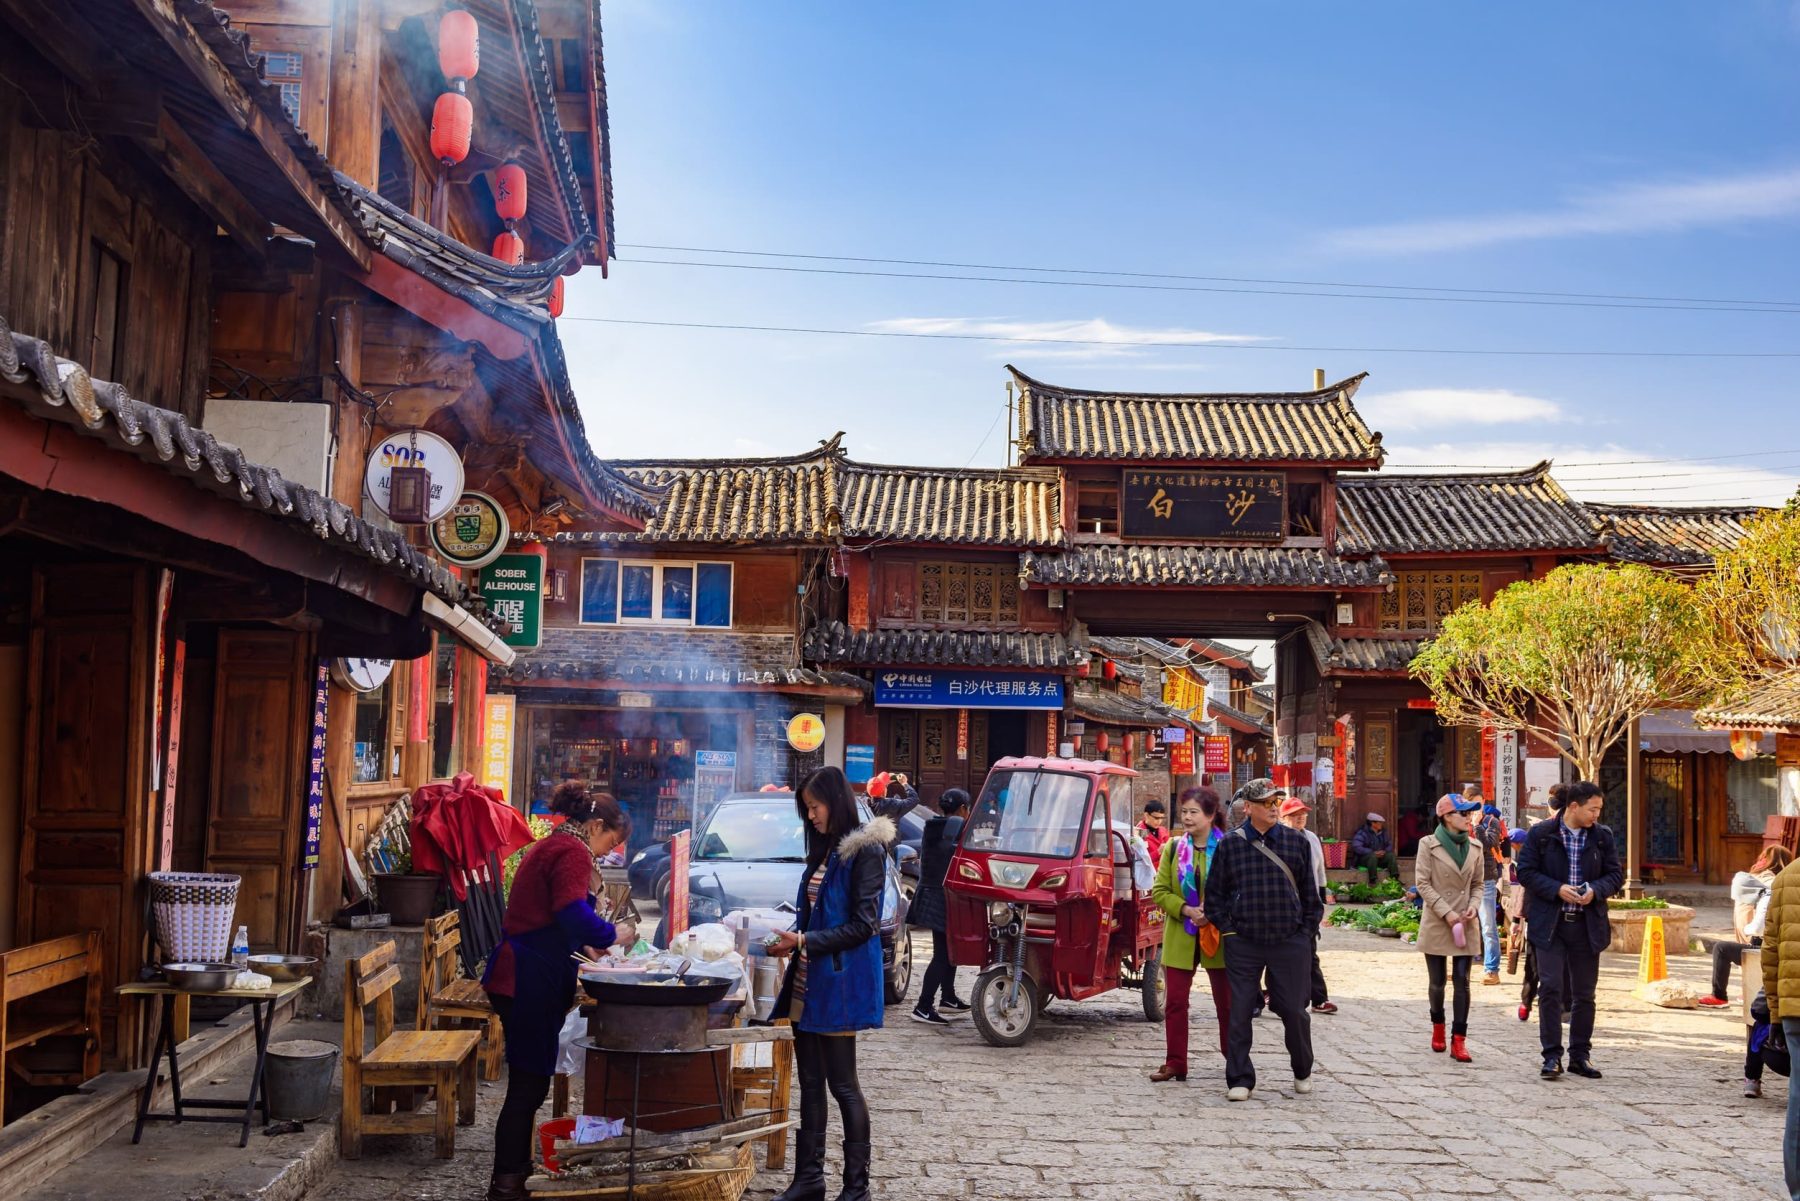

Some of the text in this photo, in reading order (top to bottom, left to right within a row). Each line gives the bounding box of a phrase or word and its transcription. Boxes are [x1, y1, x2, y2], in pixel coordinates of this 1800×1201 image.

[1146, 488, 1256, 526] 白沙
[494, 569, 527, 578] SOBER
[485, 582, 536, 591] ALEHOUSE
[949, 680, 1058, 697] 白沙代理服务点
